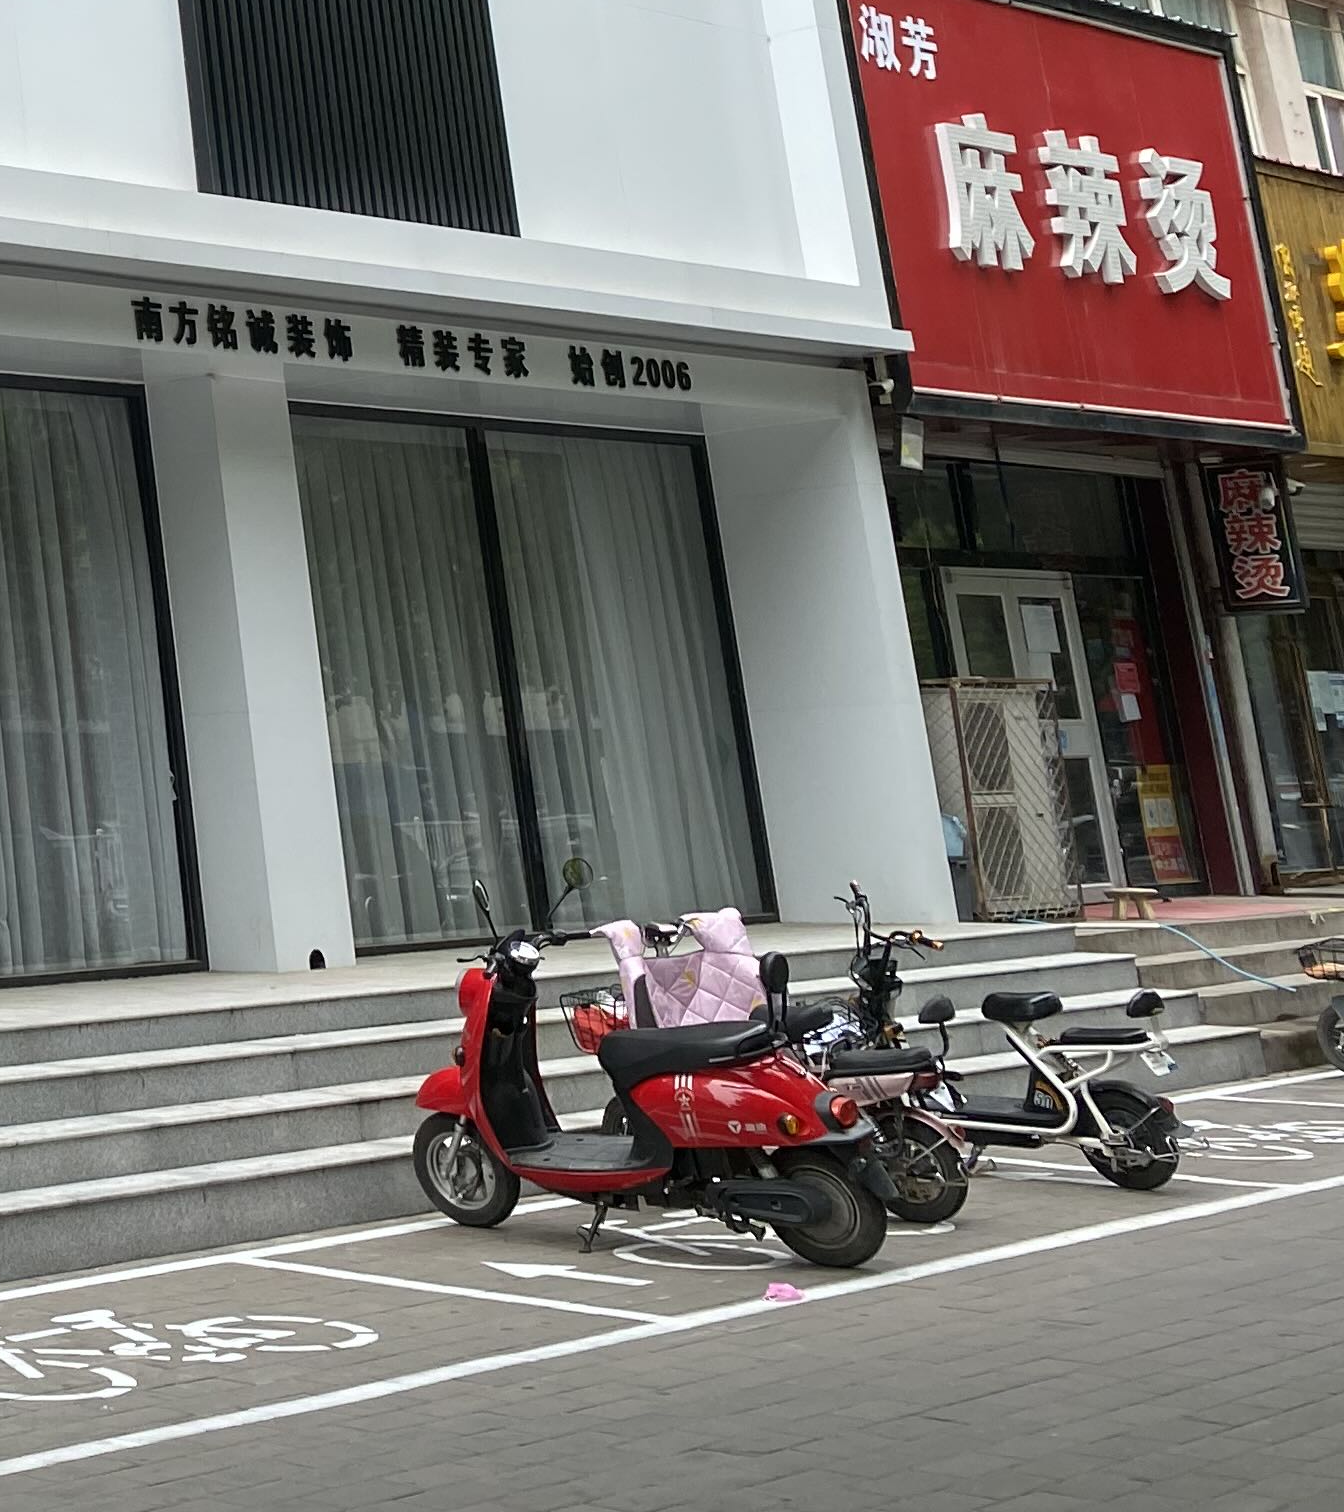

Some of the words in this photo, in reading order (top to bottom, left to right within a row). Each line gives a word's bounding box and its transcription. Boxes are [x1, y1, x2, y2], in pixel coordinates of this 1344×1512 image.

[858, 4, 937, 80] 淑芳
[932, 113, 1232, 301] 麻辣烫
[131, 296, 353, 362] 南方铭诚装饰
[396, 324, 530, 379] 精装专家
[567, 346, 692, 390] 始创2006
[1217, 468, 1291, 601] 麻辣烫
